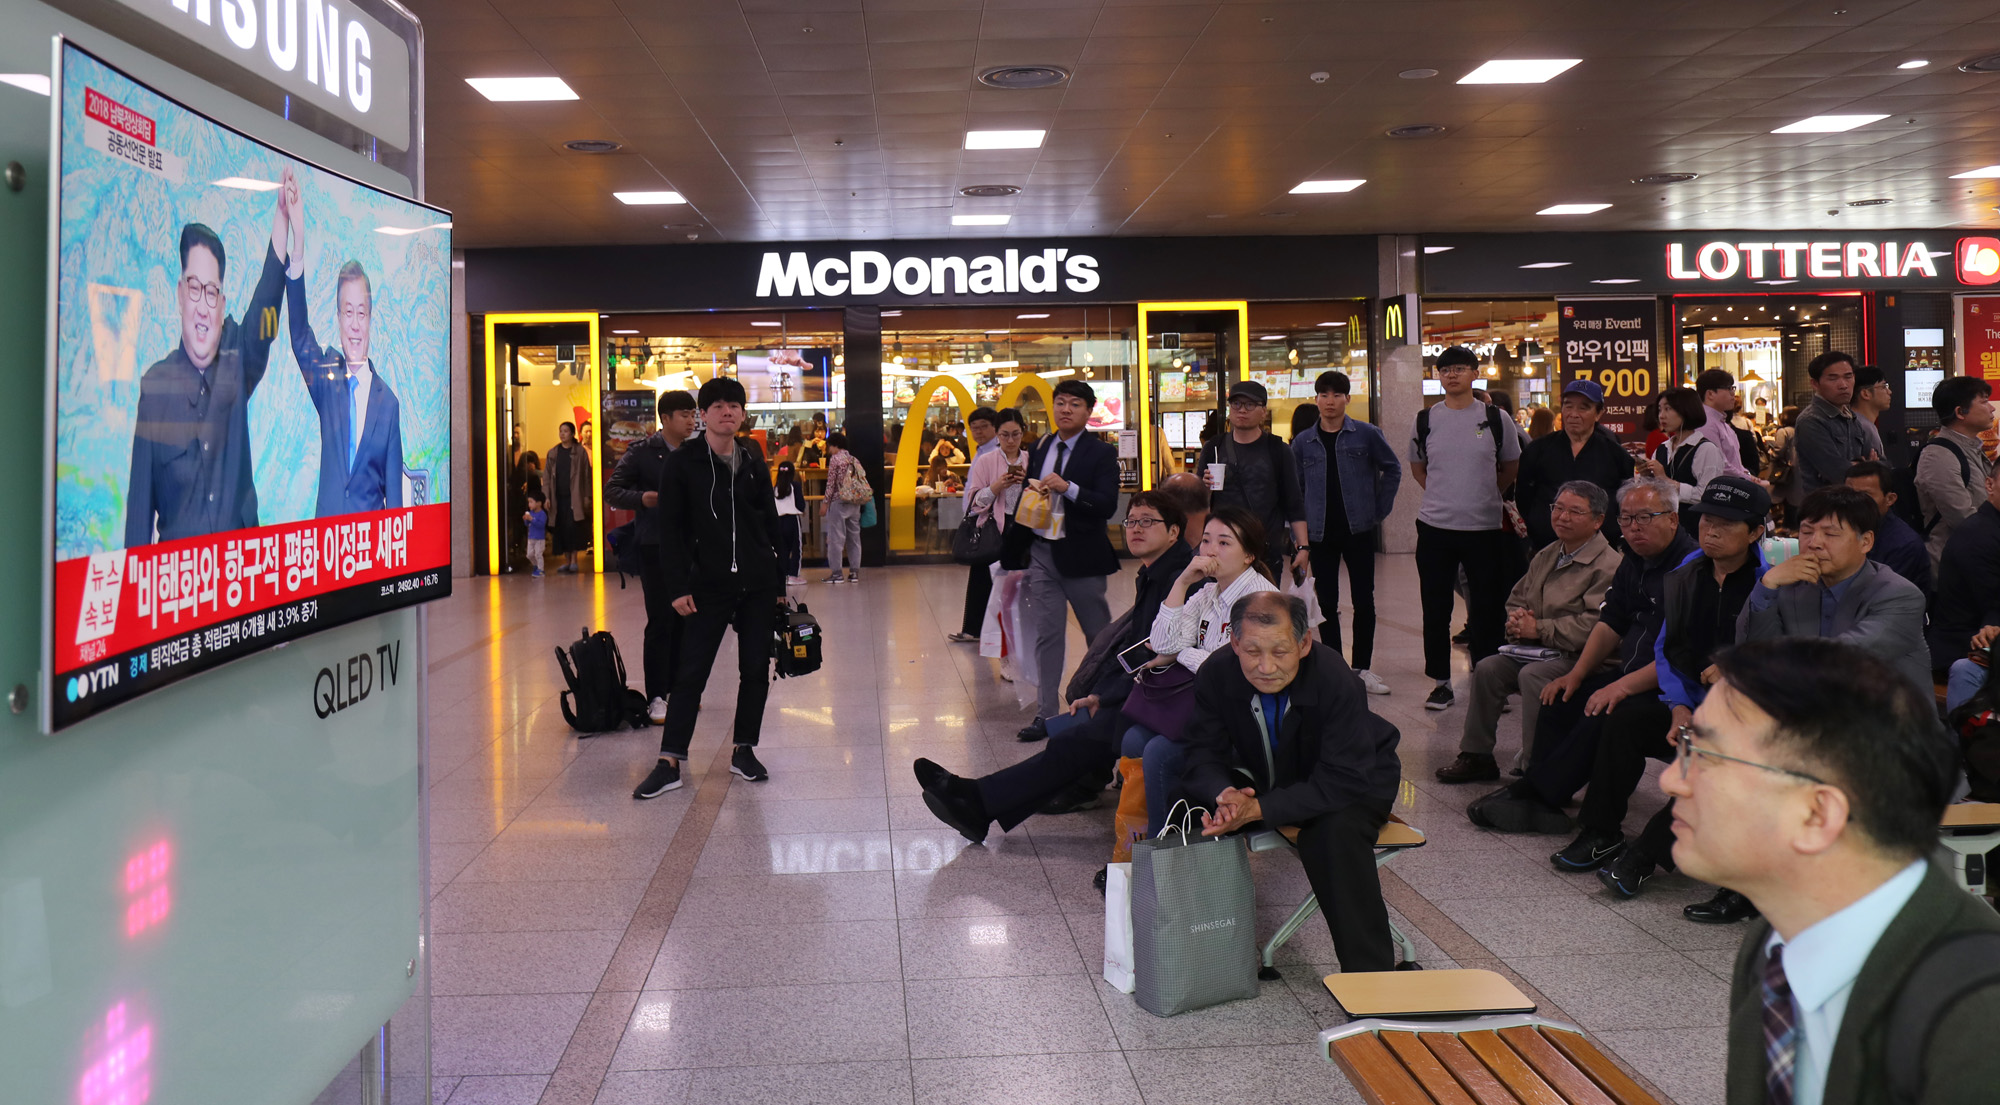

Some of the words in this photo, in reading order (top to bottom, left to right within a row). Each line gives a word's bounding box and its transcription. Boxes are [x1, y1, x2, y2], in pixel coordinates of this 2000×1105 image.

[88, 93, 109, 120] 2018
[107, 130, 146, 165] 공동선언문
[148, 148, 163, 171] 발표
[755, 248, 1100, 297] McDonald's
[1666, 241, 1938, 280] LOTTERIA
[1573, 320, 1587, 330] 우리
[1605, 317, 1642, 330] Event!
[1733, 488, 1750, 499] SPORTS
[91, 559, 120, 593] 뉴스
[129, 544, 220, 630] "비핵화와
[225, 533, 280, 608] 항구적
[285, 527, 320, 592] 평화
[324, 521, 373, 581] 이정표
[376, 511, 413, 569] 세워"
[397, 577, 420, 593] 2492.40
[84, 597, 115, 632] 속보
[129, 652, 148, 678] 경제
[150, 637, 191, 671] 퇴직연금
[191, 633, 202, 658] 총
[204, 621, 241, 652] 적립금액
[242, 613, 266, 640] 6개월
[267, 611, 276, 632] 새
[278, 606, 300, 629] 3.9%
[301, 599, 319, 623] 증가
[89, 662, 120, 694] YTN
[313, 653, 373, 720] QLED
[376, 639, 400, 692] TV
[1190, 917, 1237, 934] SHINSEGAE
